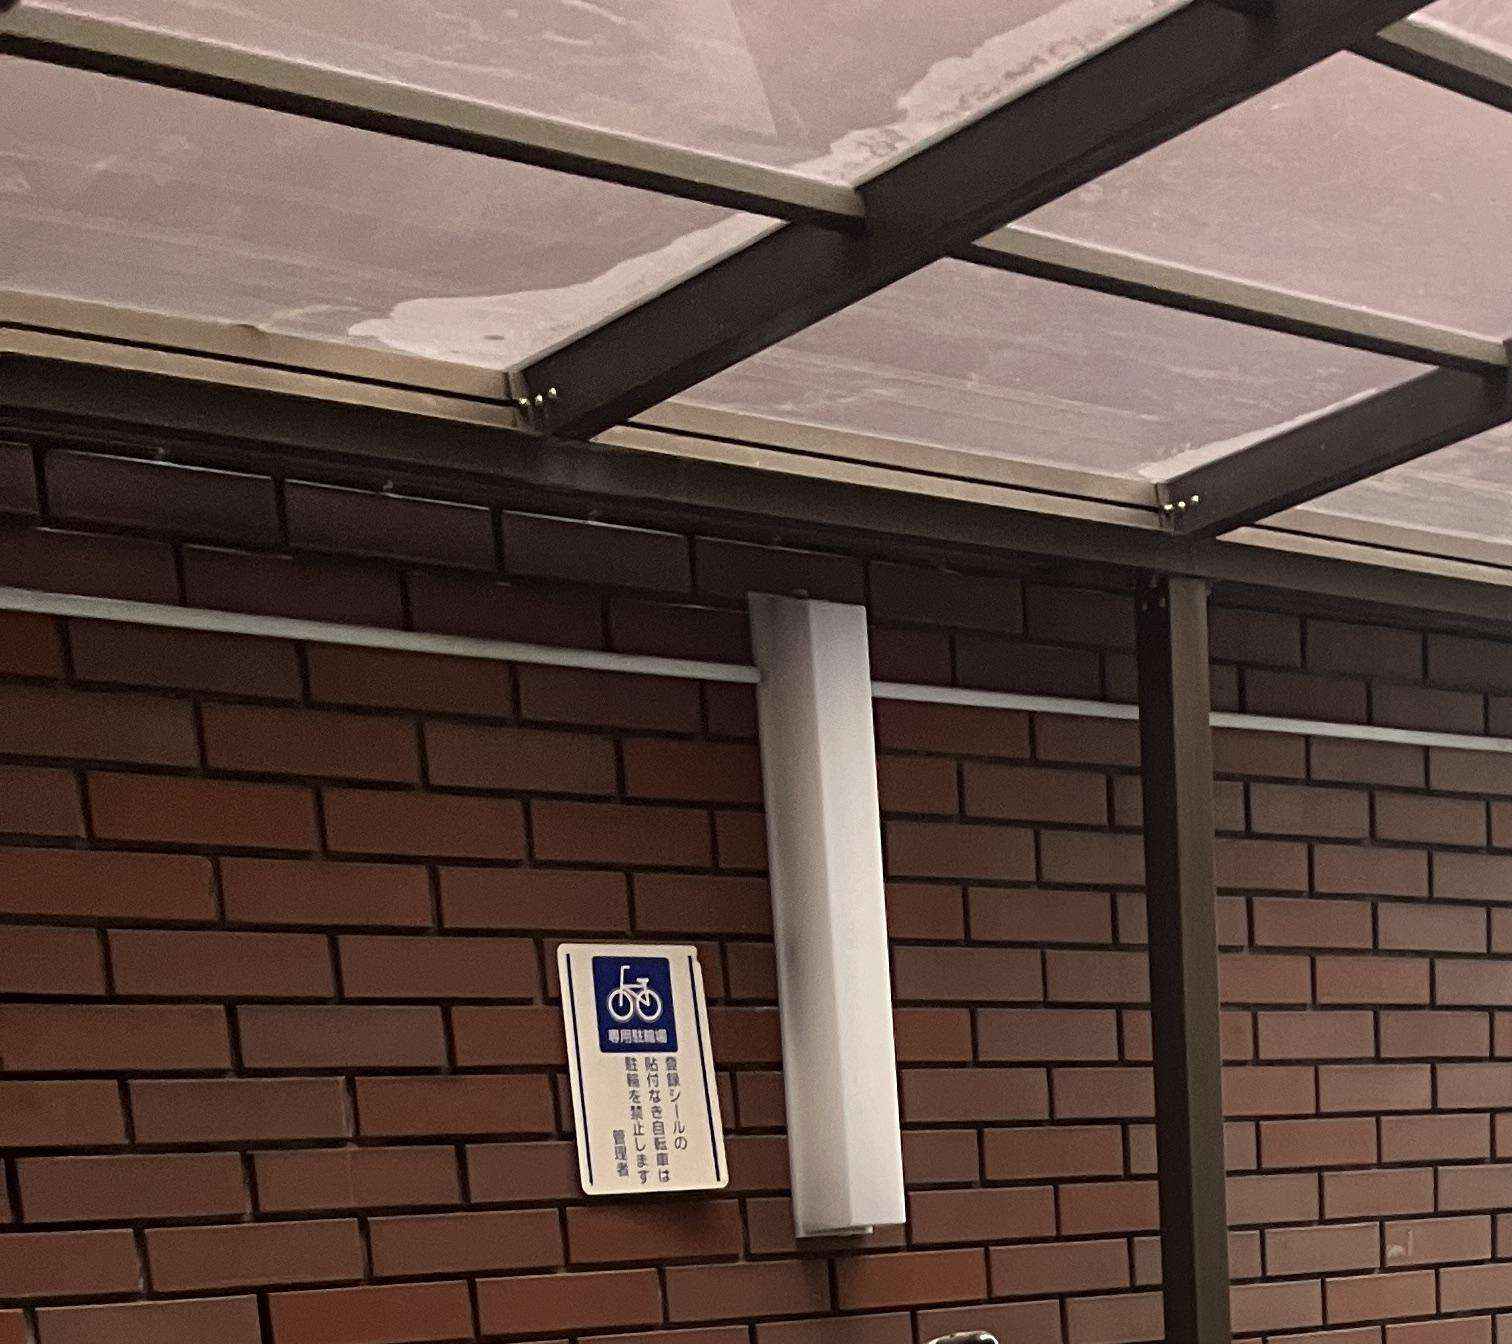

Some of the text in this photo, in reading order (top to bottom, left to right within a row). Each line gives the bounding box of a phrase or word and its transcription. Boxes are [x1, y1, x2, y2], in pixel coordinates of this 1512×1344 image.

[613, 1129, 630, 1177] 管理者
[624, 1056, 649, 1185] 駐輪を禁止します
[644, 1056, 670, 1183] 貼付なき自転車は
[665, 1056, 688, 1150] 登録シールの
